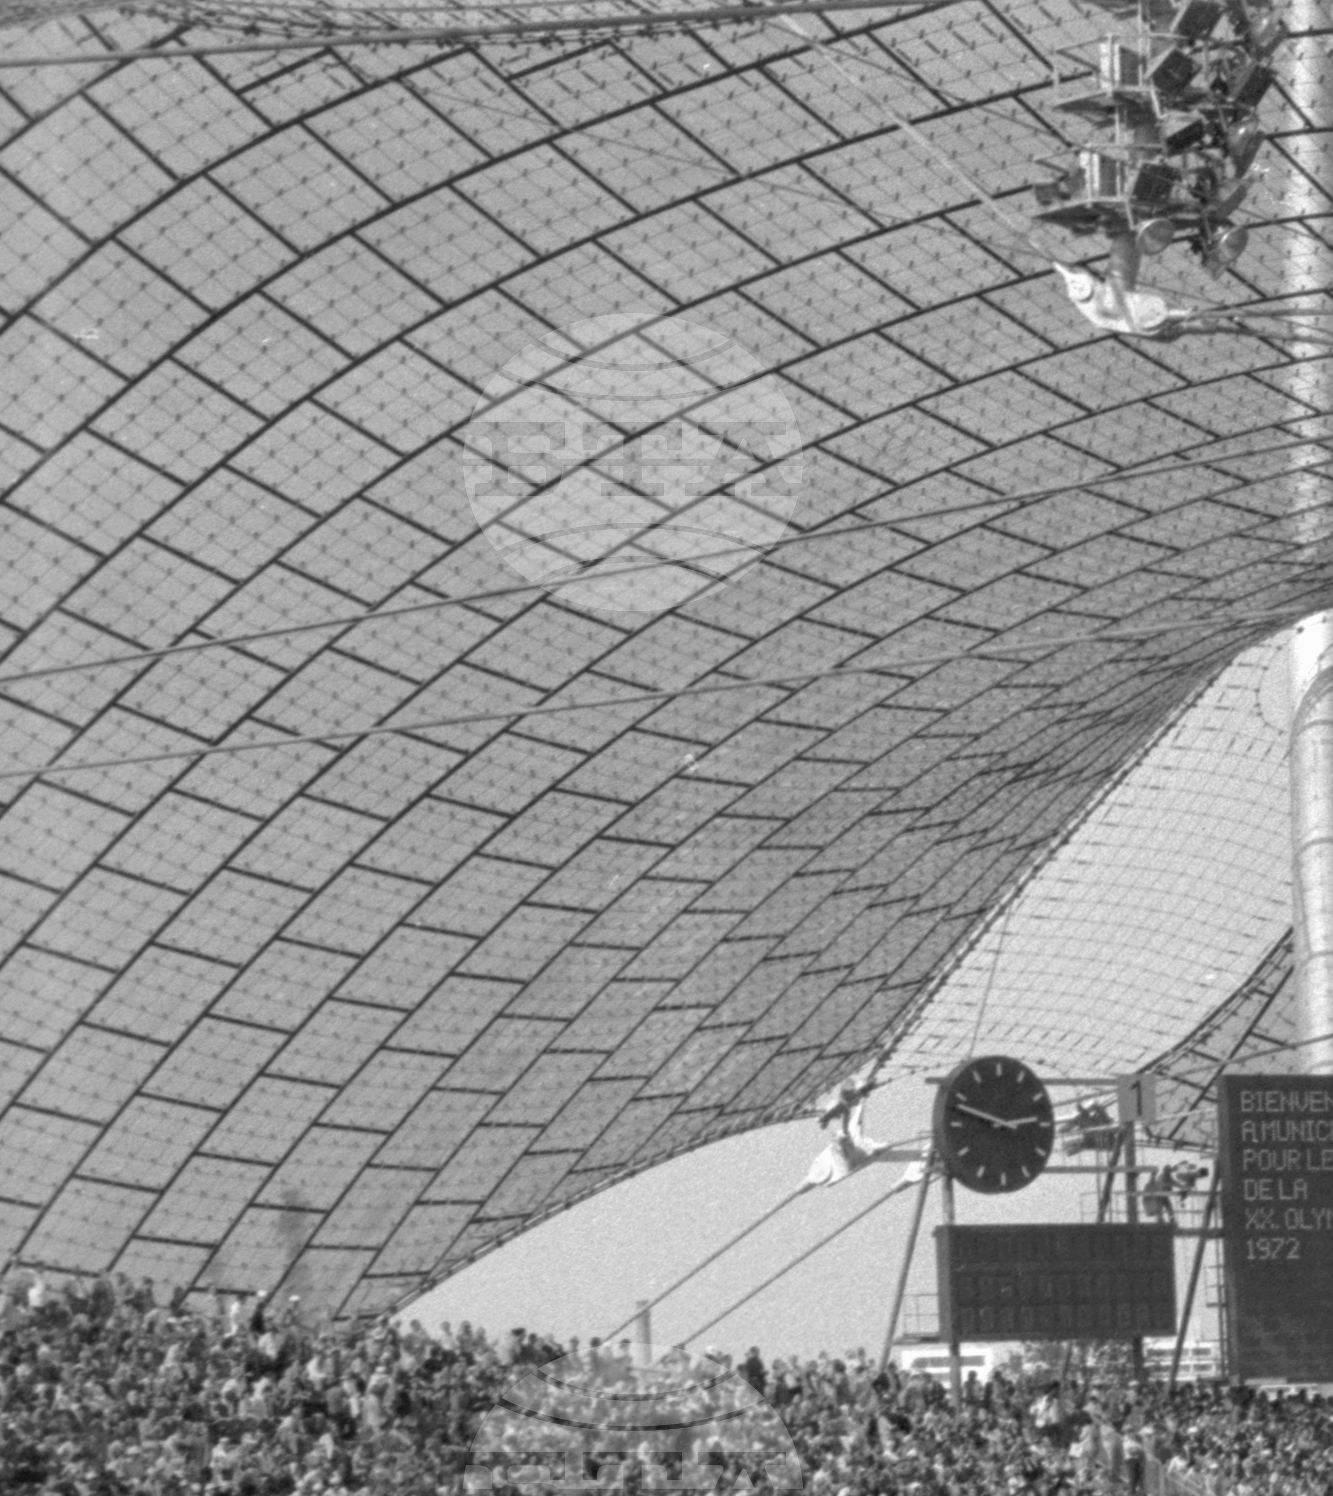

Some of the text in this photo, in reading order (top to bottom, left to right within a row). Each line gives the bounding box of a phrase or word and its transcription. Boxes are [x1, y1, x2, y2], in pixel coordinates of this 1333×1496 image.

[1130, 1080, 1142, 1116] 1
[1242, 1148, 1302, 1171] POUR
[1243, 1178, 1308, 1201] DE LA
[1246, 1237, 1300, 1260] 1972
